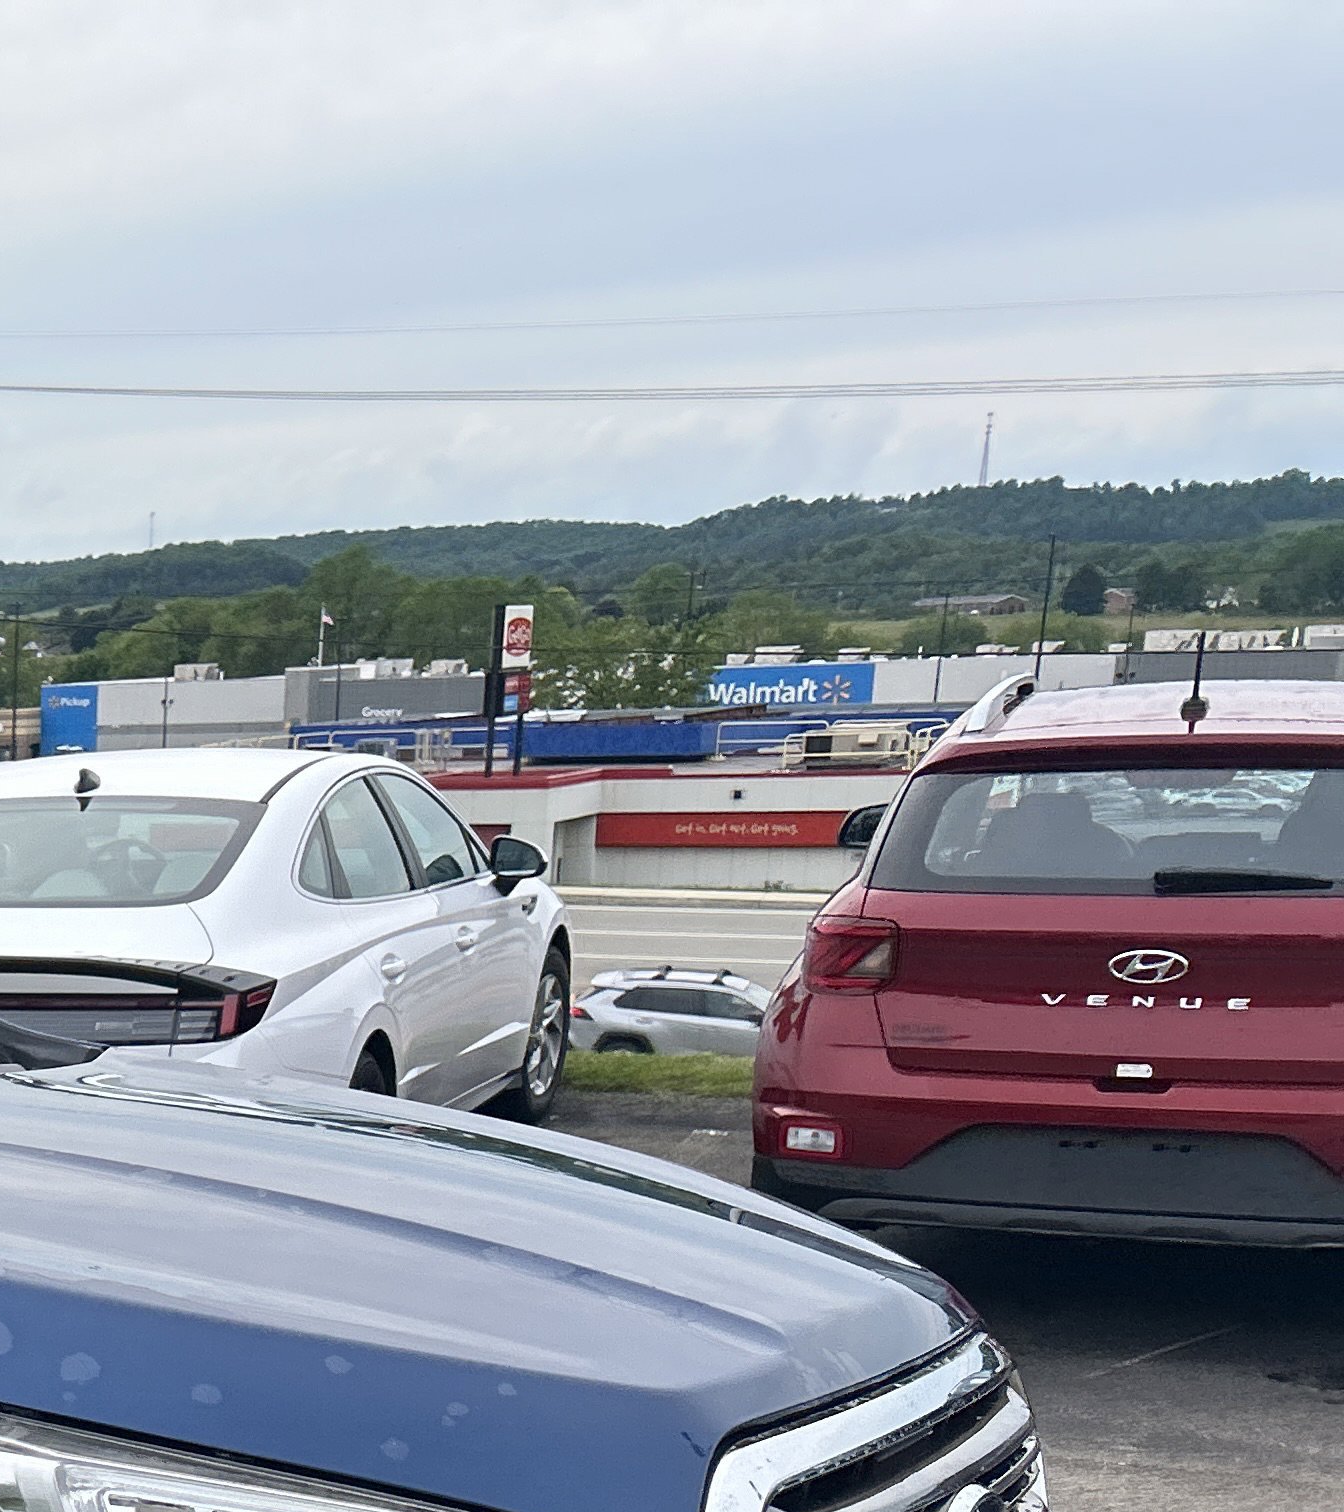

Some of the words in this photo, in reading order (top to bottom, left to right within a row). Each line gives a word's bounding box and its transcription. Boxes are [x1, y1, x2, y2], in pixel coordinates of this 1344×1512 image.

[708, 677, 818, 705] Walmart
[60, 697, 90, 707] Pickup
[361, 706, 403, 718] Grocery
[1041, 993, 1251, 1011] VENUE
